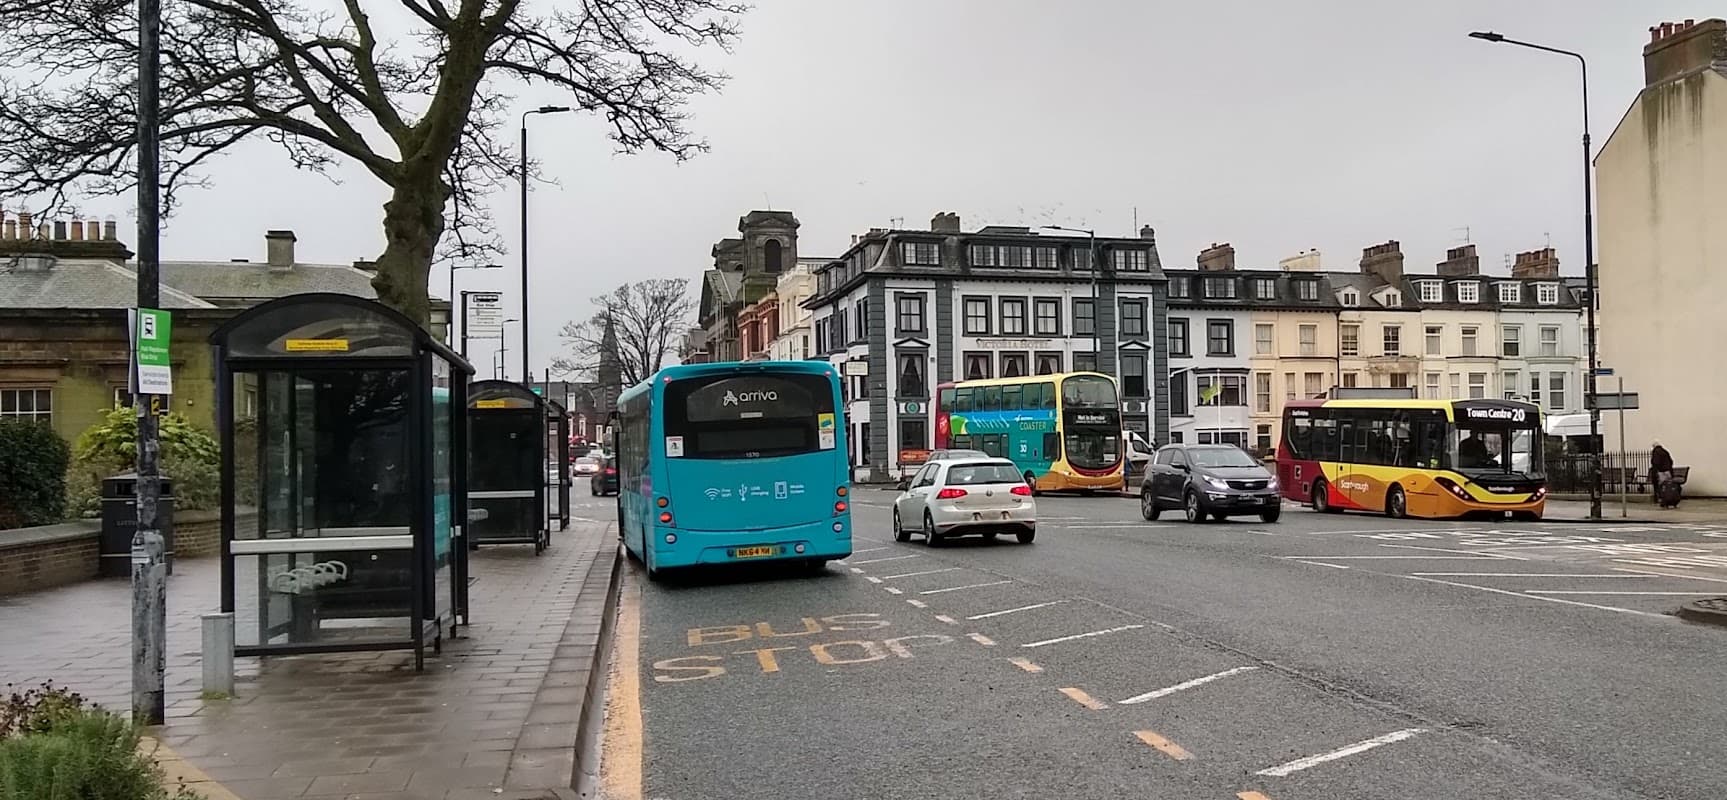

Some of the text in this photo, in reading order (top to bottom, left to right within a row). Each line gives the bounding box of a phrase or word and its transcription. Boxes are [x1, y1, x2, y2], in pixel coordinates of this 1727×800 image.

[739, 390, 778, 402] arriva
[1467, 408, 1512, 419] Town Centre
[1512, 409, 1526, 422] 20
[1020, 421, 1047, 431] COASTER
[688, 613, 890, 647] BUS
[653, 633, 956, 683] STOP
